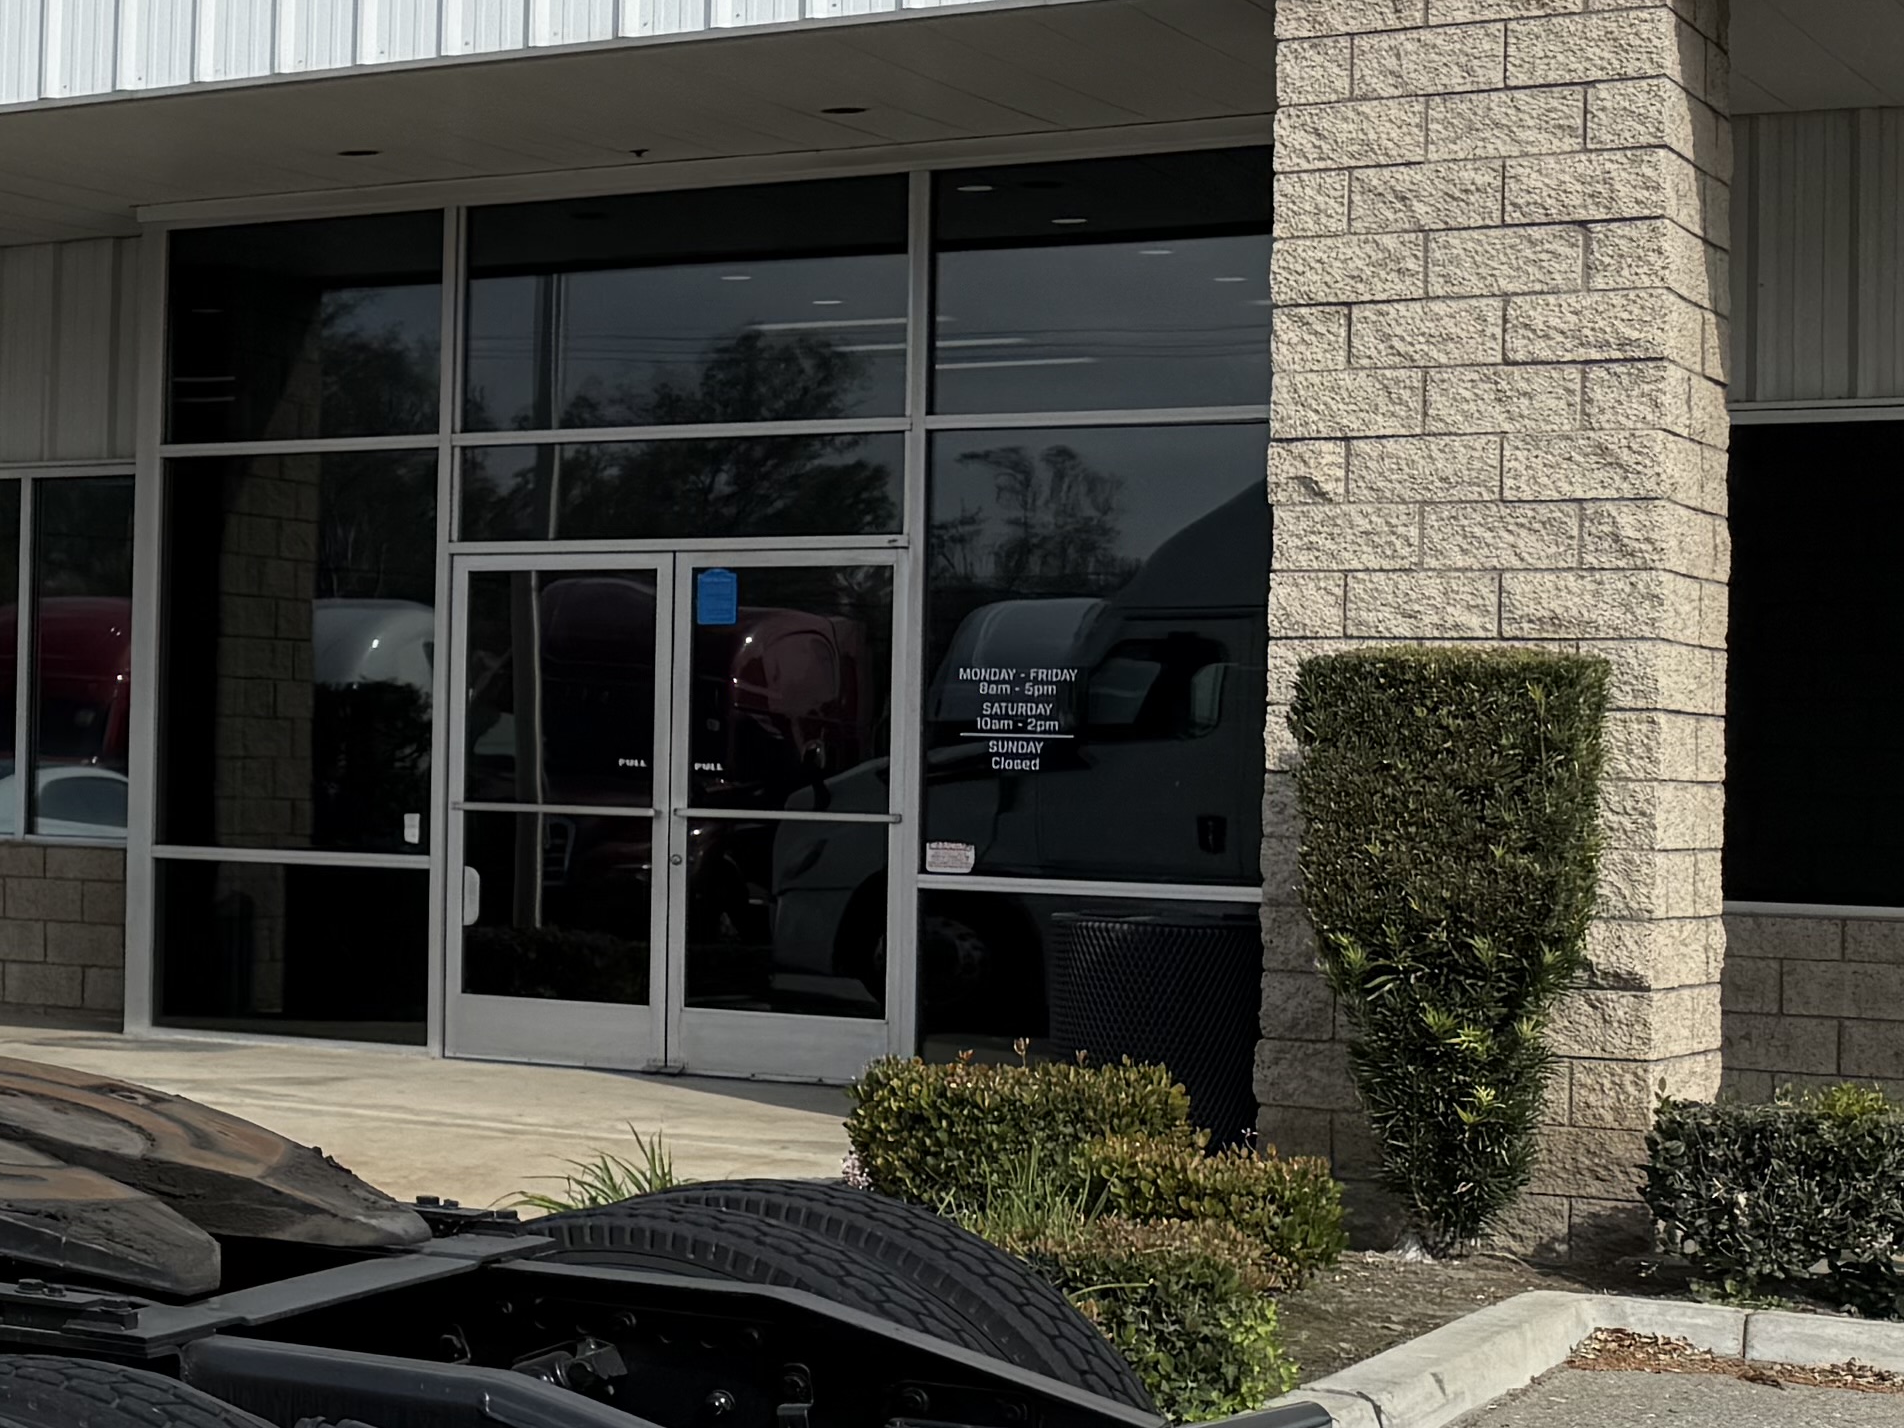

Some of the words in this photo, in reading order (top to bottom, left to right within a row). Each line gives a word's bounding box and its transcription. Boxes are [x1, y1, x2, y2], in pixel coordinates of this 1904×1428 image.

[959, 668, 1016, 680] MONDAY
[1030, 669, 1078, 682] FRIDAY
[979, 682, 1010, 694] 8am
[1024, 682, 1056, 697] 5pm
[982, 702, 1053, 716] SATURDAY
[977, 717, 1013, 730] 10am
[1027, 718, 1059, 732] 2pm
[989, 740, 1044, 754] SUNDAY
[618, 758, 647, 767] PULL
[694, 763, 723, 771] PULL
[992, 756, 1040, 770] Closed
